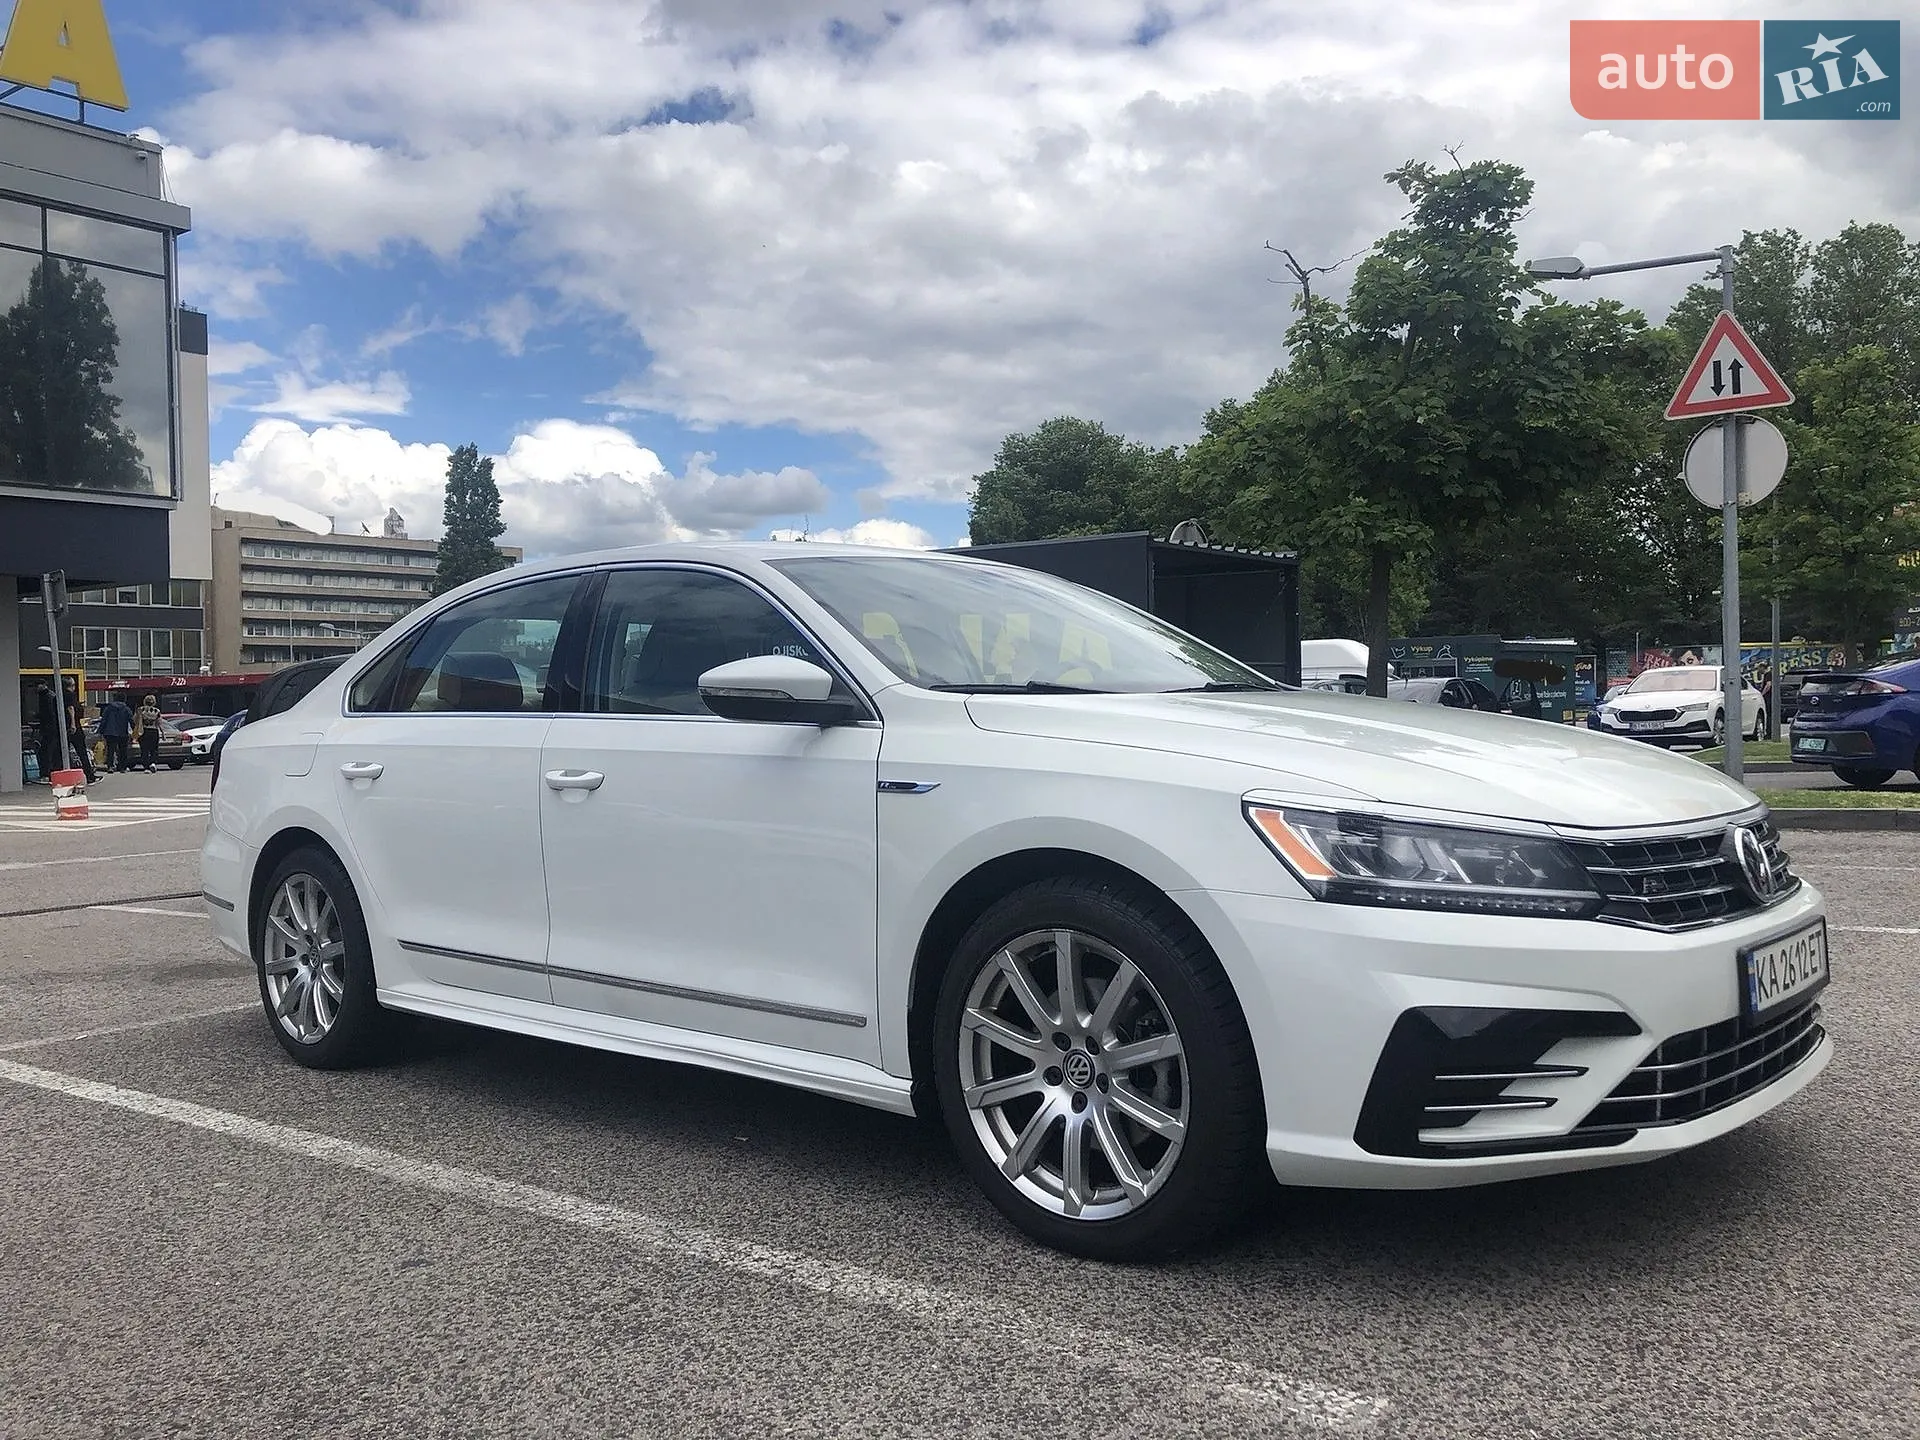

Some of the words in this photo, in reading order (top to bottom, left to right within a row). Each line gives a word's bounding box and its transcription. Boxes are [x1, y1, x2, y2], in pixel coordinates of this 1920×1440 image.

[1756, 953, 1780, 1003] KA
[1780, 939, 1809, 991] 2612
[1808, 929, 1822, 974] ET
